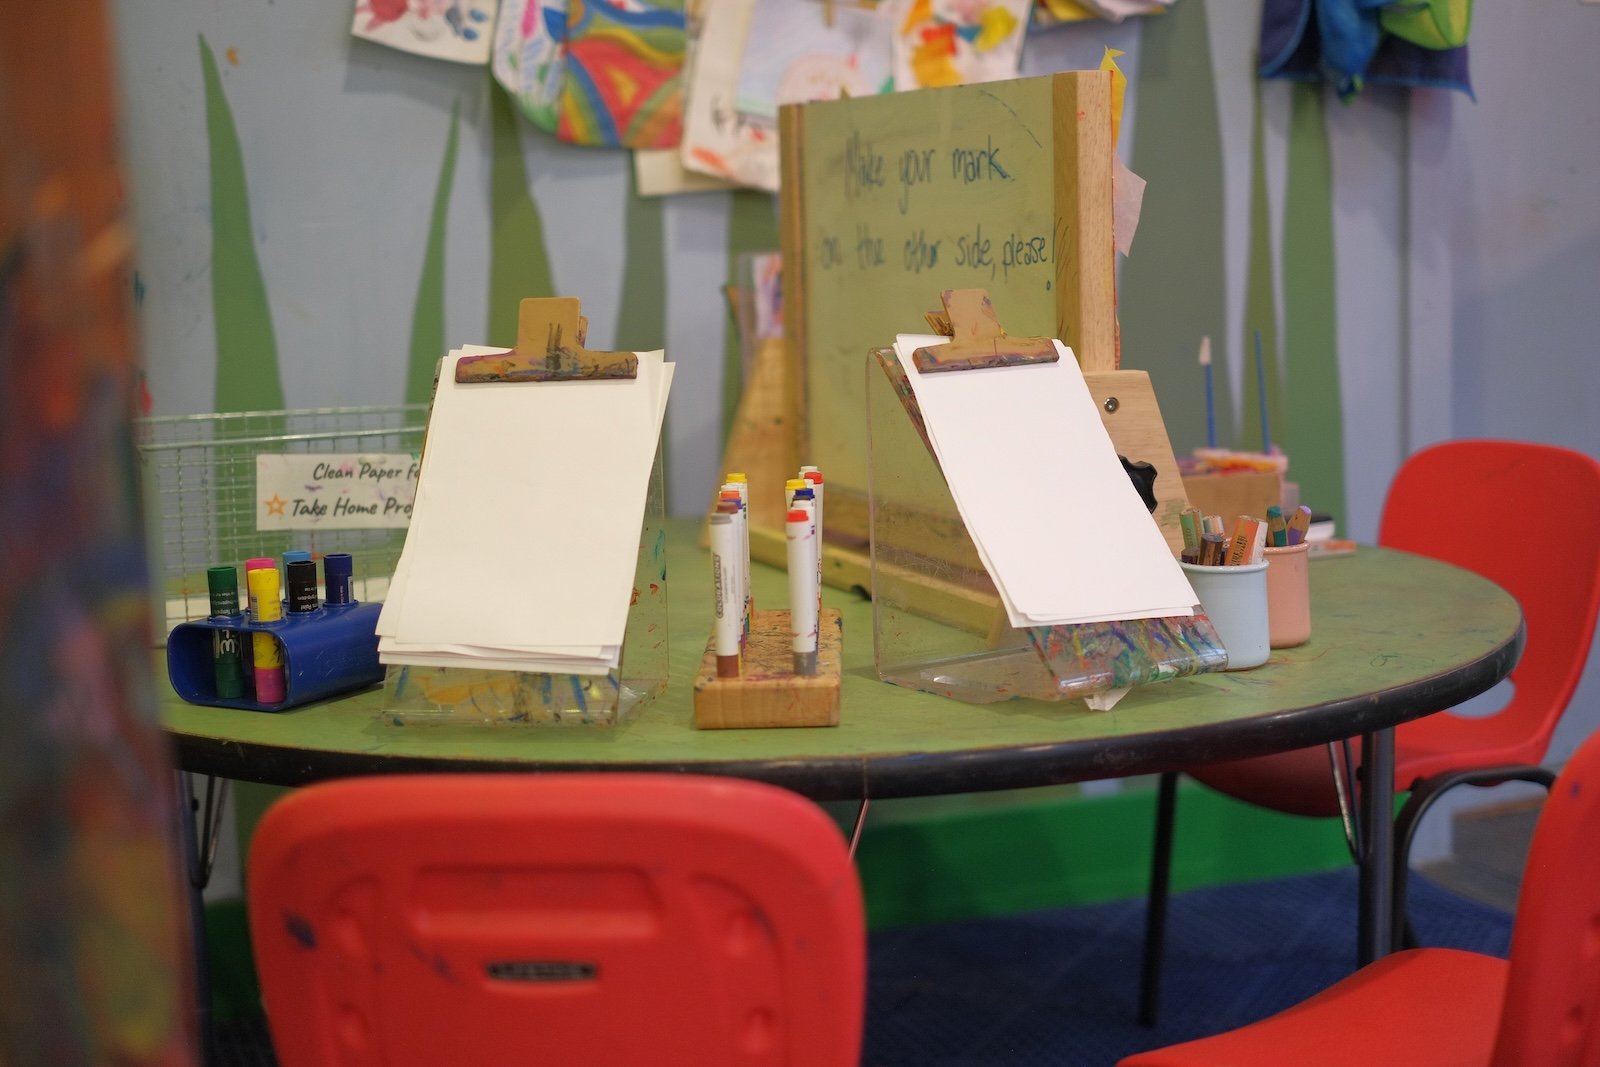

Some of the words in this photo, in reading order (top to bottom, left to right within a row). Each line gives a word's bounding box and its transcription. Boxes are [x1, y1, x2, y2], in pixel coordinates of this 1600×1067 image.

[844, 128, 886, 198] Make
[898, 148, 936, 215] your
[820, 235, 843, 270] on
[855, 223, 886, 271] the
[955, 223, 996, 281] side,
[312, 462, 353, 481] Clean
[358, 463, 403, 483] Paper
[406, 462, 421, 481] fo
[292, 498, 327, 517] Take
[333, 497, 378, 517] Home
[383, 496, 413, 520] Pro
